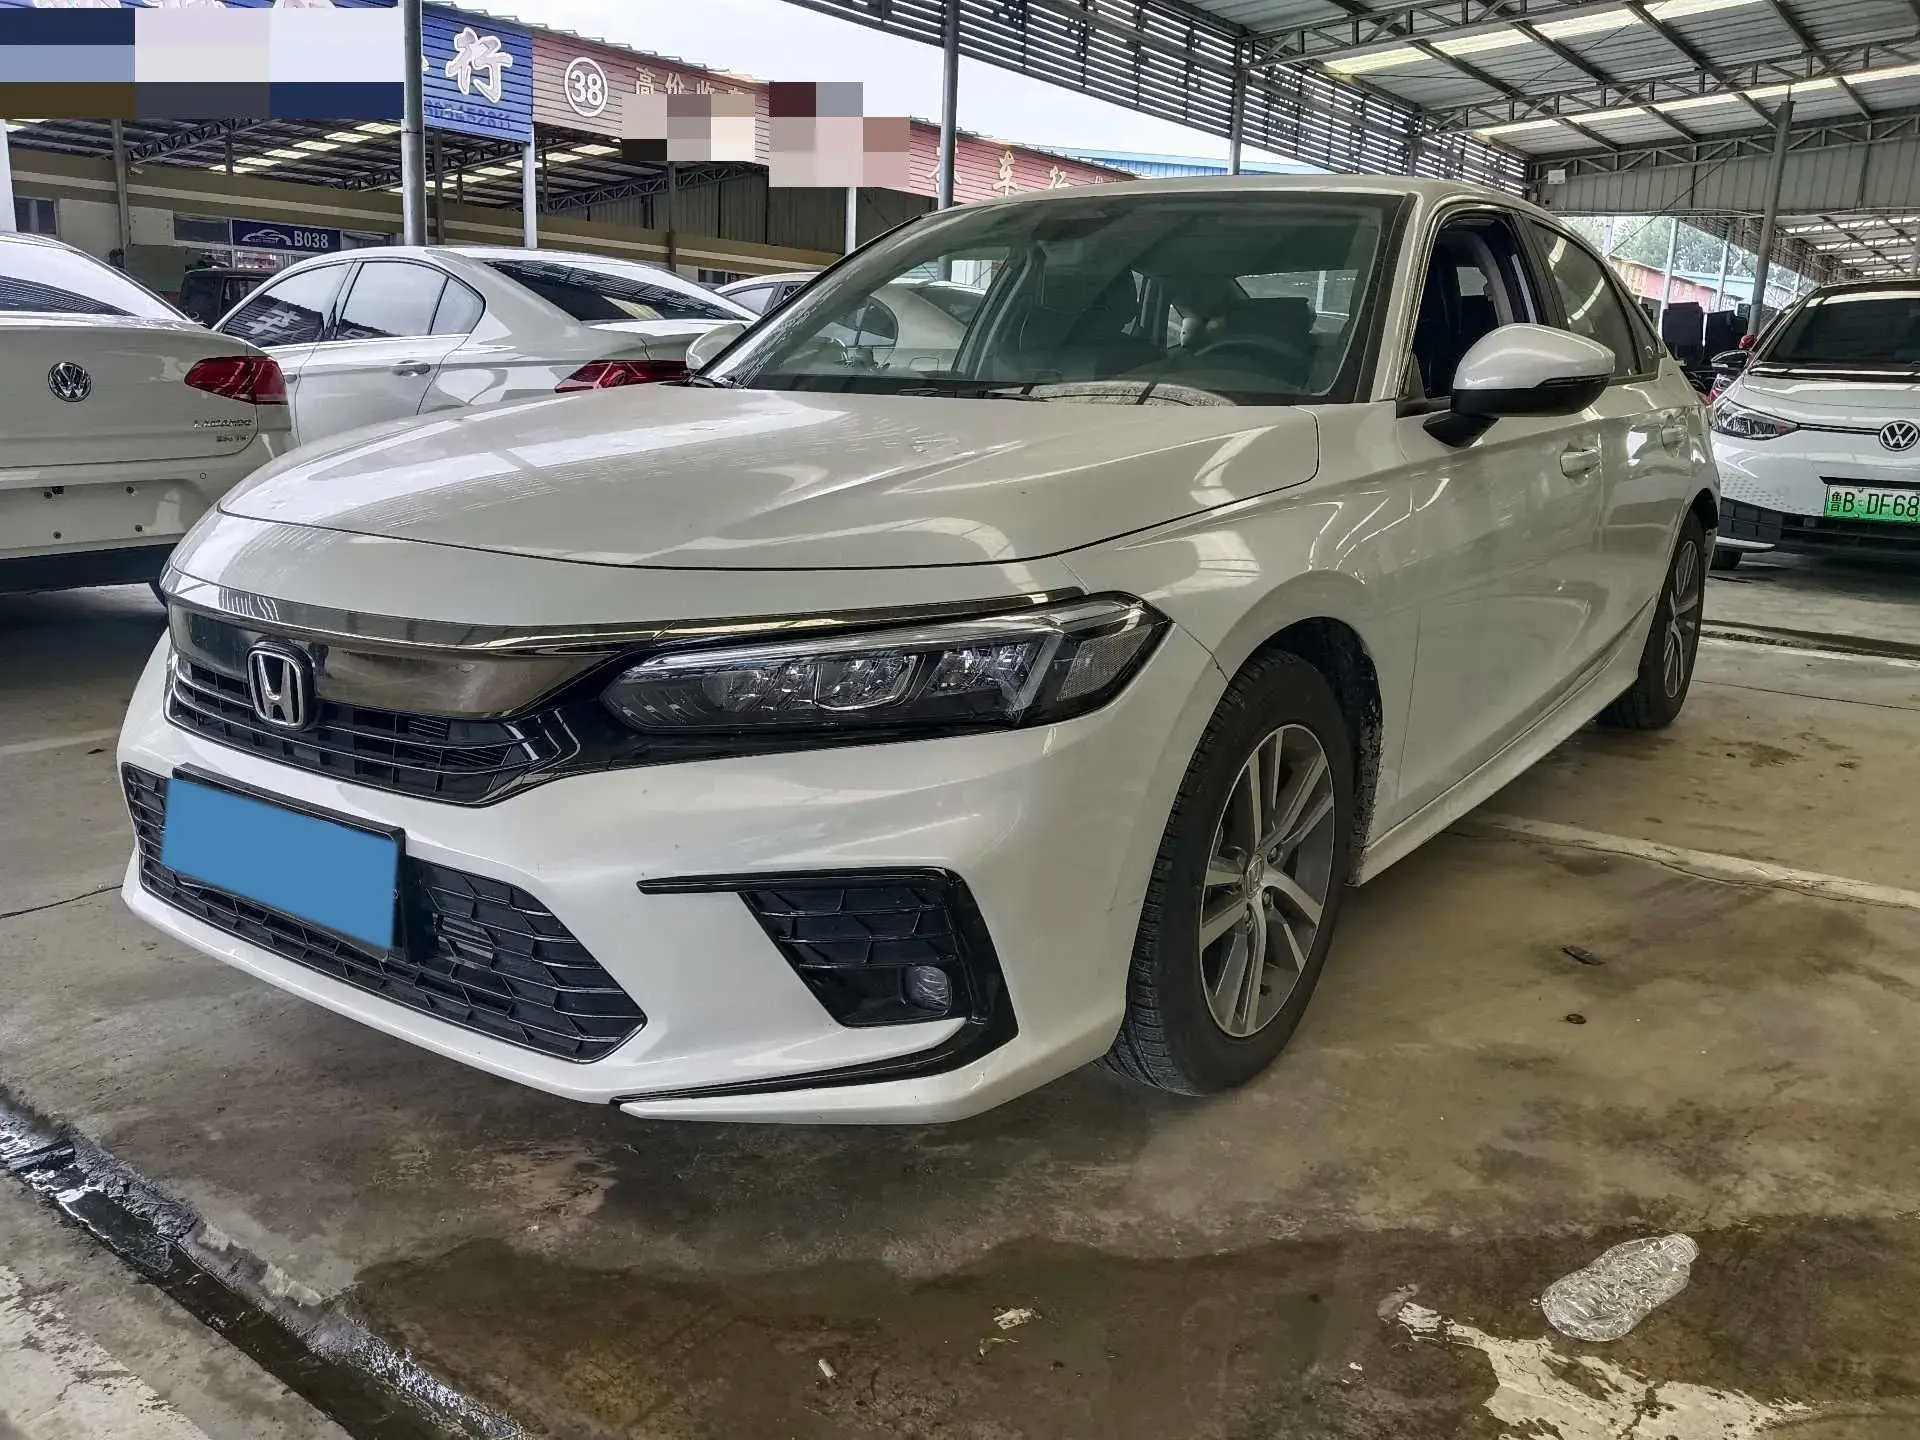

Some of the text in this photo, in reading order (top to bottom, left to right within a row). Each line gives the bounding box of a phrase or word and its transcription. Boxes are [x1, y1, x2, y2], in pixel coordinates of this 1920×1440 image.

[445, 26, 514, 104] 行
[570, 69, 603, 106] 38
[294, 230, 329, 249] B038
